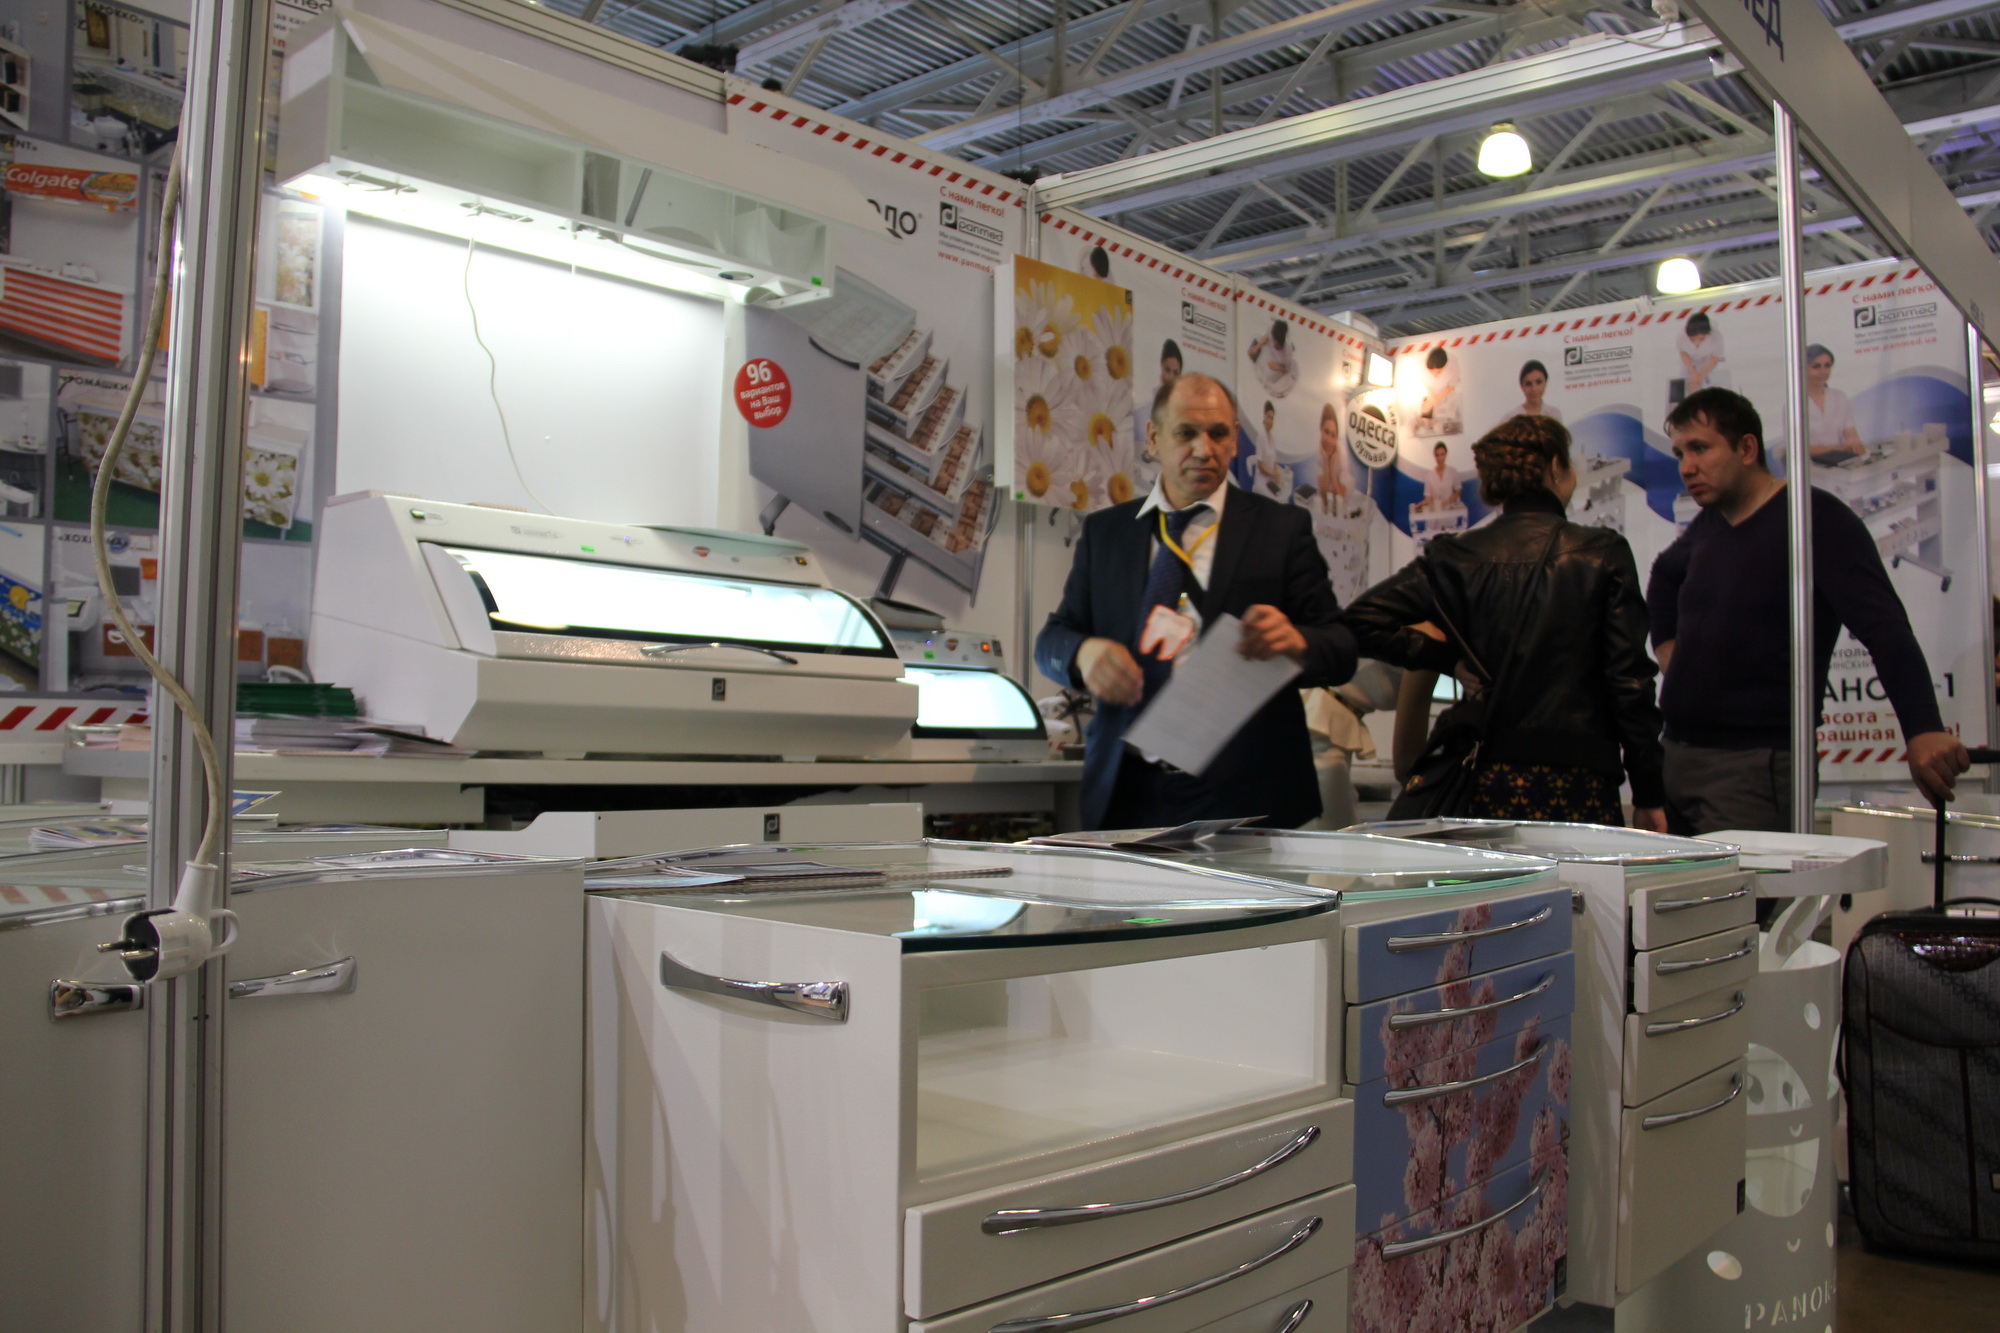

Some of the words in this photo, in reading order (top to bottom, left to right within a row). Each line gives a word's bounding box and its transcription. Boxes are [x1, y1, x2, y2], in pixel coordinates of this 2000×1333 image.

[6, 167, 80, 190] Colgate
[948, 191, 975, 207] нами
[976, 200, 1005, 218] легко!
[959, 221, 1003, 242] panmed
[937, 251, 994, 275] www.panmed.
[1852, 294, 1860, 304] С
[1862, 291, 1896, 302] нами
[1878, 302, 1938, 324] panmed
[746, 361, 772, 385] 96
[740, 382, 786, 399] вариантов
[749, 399, 761, 409] на
[761, 394, 781, 406] Ваш
[753, 405, 782, 420] выбор
[1822, 711, 1877, 725] асота
[1816, 728, 1896, 742] рашная
